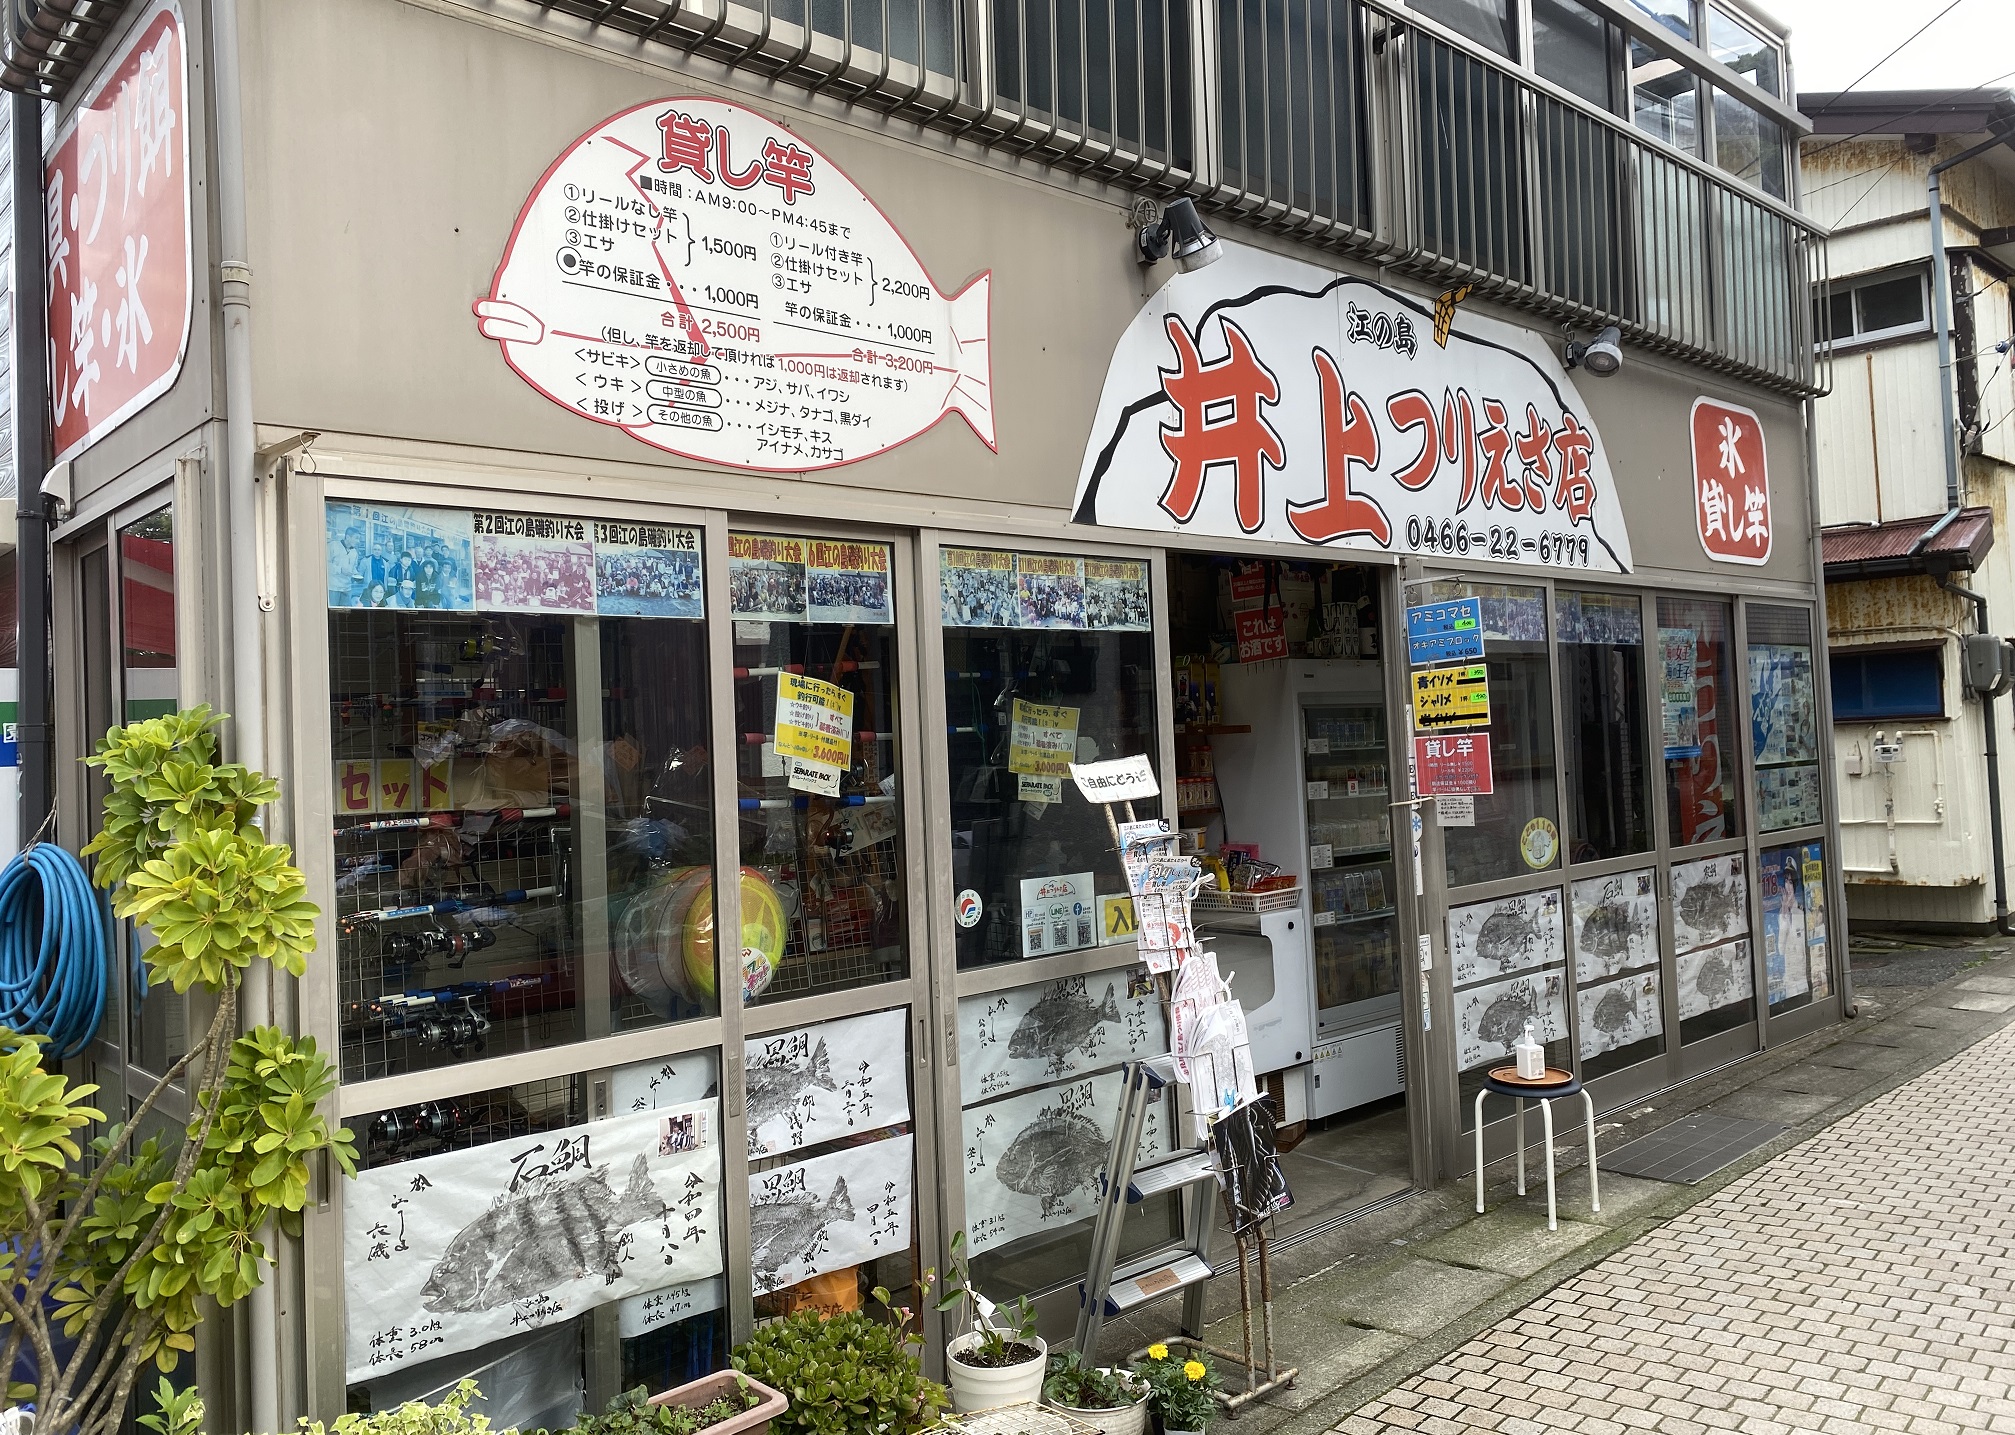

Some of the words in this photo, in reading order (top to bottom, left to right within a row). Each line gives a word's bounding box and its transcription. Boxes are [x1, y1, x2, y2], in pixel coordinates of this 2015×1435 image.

[656, 108, 815, 205] 貸し竿
[564, 206, 678, 245] ②仕掛けセット
[565, 229, 615, 253] ③エサ
[701, 236, 758, 262] 1,500円
[769, 231, 863, 267] ①リール付き竿
[770, 252, 863, 286] ②仕掛けセット
[771, 272, 812, 294] ③エサ
[881, 276, 931, 301] 2,200円
[701, 316, 761, 343] 2,500円
[1346, 301, 1418, 360] 江の島
[655, 362, 711, 381] 小さめの魚
[662, 385, 707, 404] 中型の魚
[658, 407, 714, 428] その他の魚
[1157, 312, 1596, 548] 井上つりえさ店
[756, 438, 844, 461] アイナメ、カサゴ
[1718, 416, 1746, 479] 氷
[1701, 478, 1769, 547] 貸し竿
[1405, 514, 1590, 567] 0466-22-6779
[1242, 616, 1278, 637] これは
[1412, 605, 1471, 624] アミコマセ
[1240, 637, 1285, 659] お酒です
[1412, 634, 1479, 650] オキアミブロック
[1425, 738, 1473, 759] 貸し竿
[342, 762, 448, 809] セット
[793, 767, 818, 778] SEPARATE
[818, 772, 832, 781] PACK
[1051, 908, 1063, 916] LINE
[763, 1033, 809, 1068] 黒鯛
[509, 1134, 591, 1193] 石鯛
[762, 1167, 806, 1198] 黒鯛
[677, 1172, 706, 1244] 令和四年
[655, 1202, 679, 1266] 十月八日
